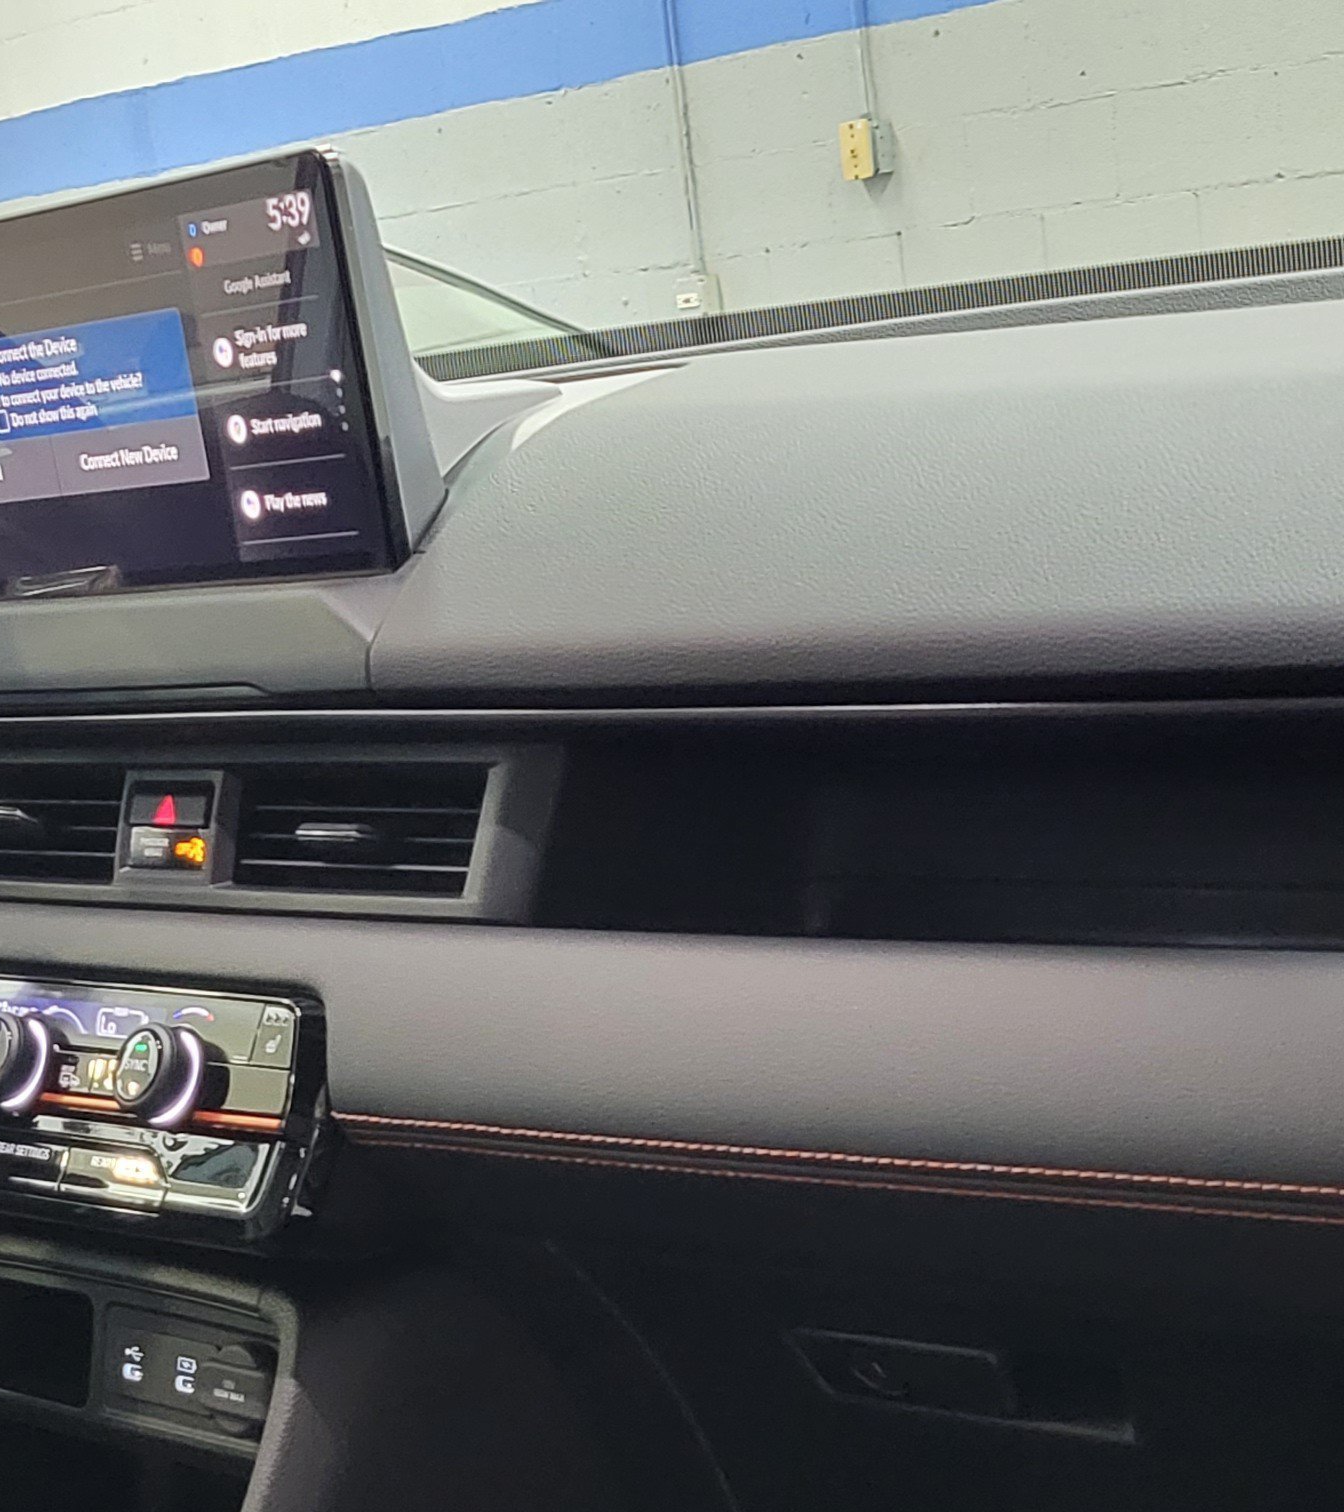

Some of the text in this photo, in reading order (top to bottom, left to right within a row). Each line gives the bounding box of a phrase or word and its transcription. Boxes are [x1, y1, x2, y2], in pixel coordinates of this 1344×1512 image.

[266, 191, 311, 231] 5:39
[224, 270, 292, 294] Google Assistant
[268, 324, 282, 340] for
[283, 323, 308, 339] more
[29, 341, 43, 359] the
[44, 336, 79, 358] Device
[239, 351, 278, 369] features
[11, 368, 36, 385] device
[1, 392, 10, 407] to
[11, 389, 41, 406] connect
[41, 386, 60, 404] your
[60, 382, 86, 398] device
[86, 381, 96, 396] to
[96, 377, 111, 393] the
[111, 371, 144, 392] vehicle?
[11, 402, 99, 427] Do not show this again
[250, 411, 322, 435] Start navigation
[79, 450, 121, 471] Connect
[121, 448, 143, 468] New
[144, 443, 179, 464] Device
[264, 492, 327, 513] Play the news
[124, 1059, 149, 1071] SYNC
